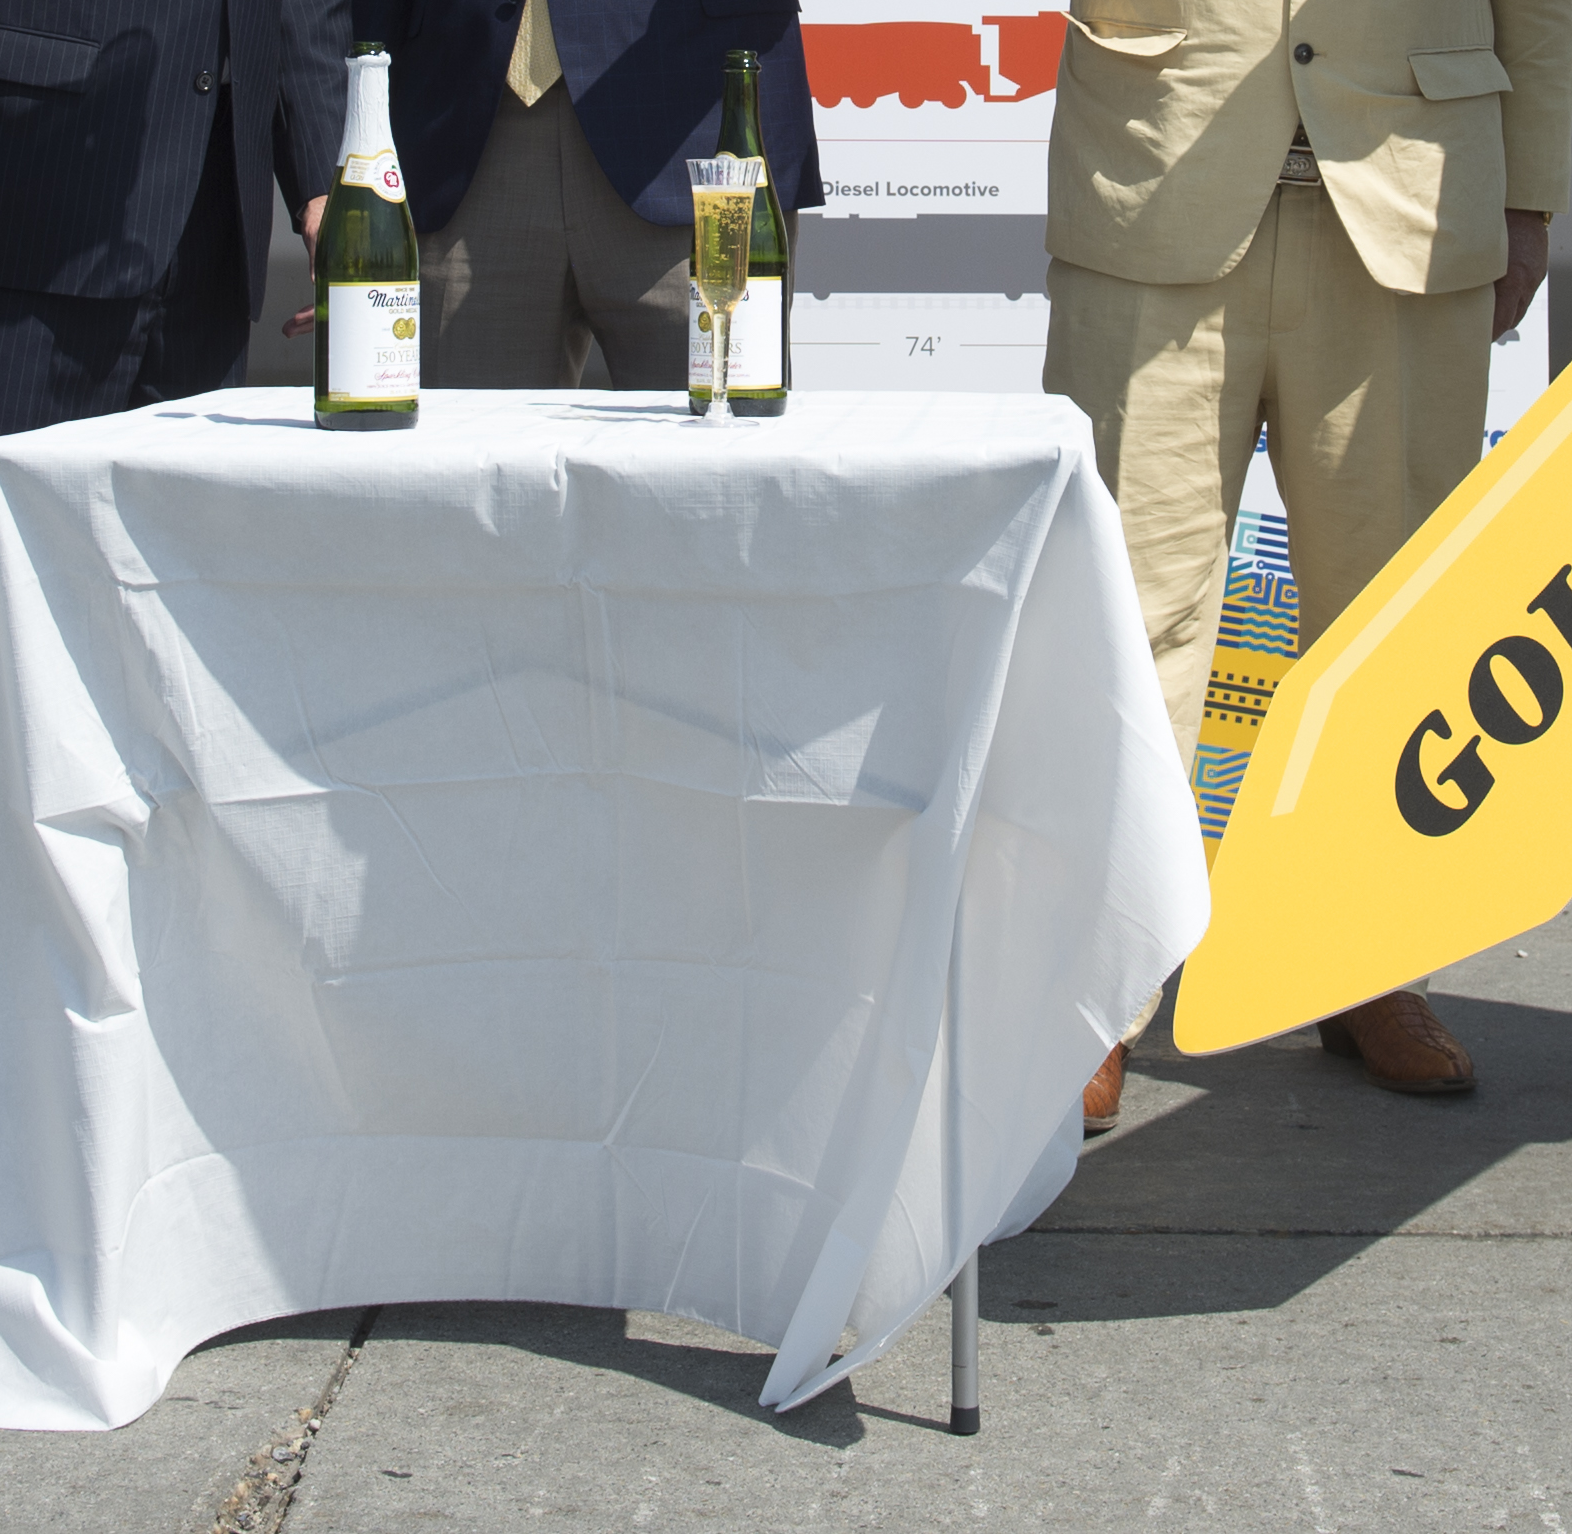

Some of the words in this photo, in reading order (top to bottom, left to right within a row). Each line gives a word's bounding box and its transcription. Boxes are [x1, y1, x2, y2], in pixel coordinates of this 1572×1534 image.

[822, 180, 879, 197] Diesel
[886, 180, 1000, 197] Locomotive
[376, 351, 396, 364] 150
